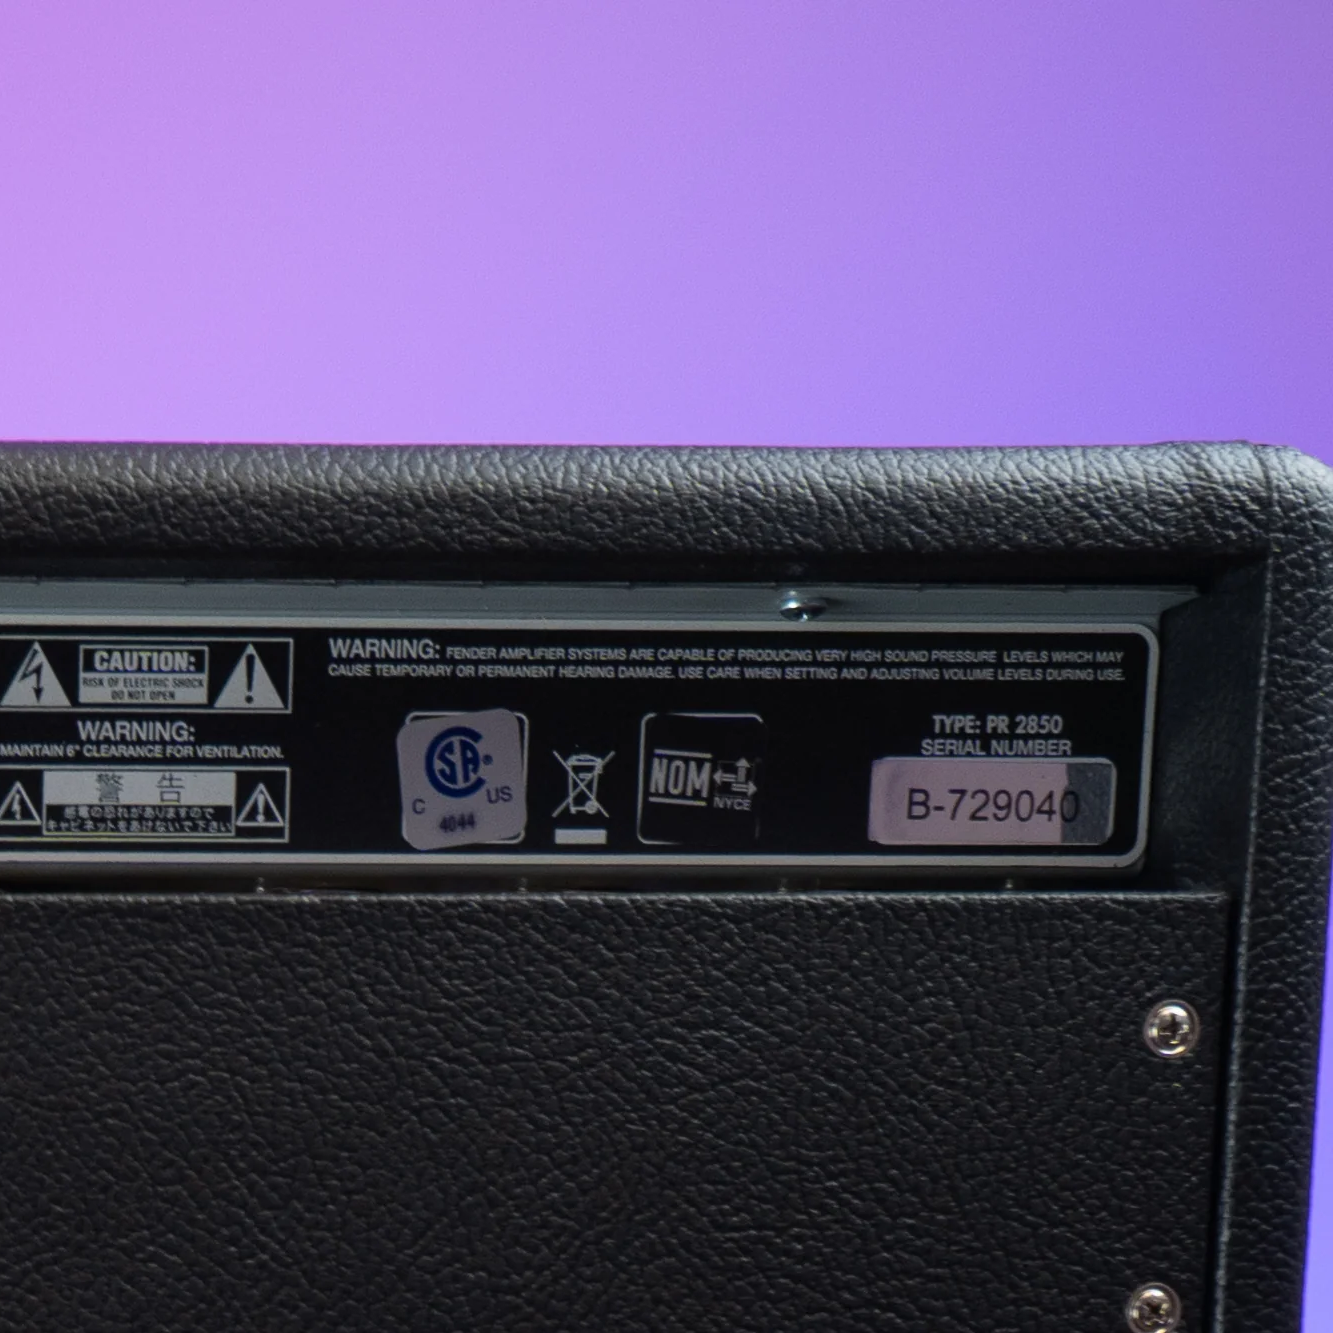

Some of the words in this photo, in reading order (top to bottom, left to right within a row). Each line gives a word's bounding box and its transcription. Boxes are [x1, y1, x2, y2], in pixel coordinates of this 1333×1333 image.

[328, 637, 440, 660] WARNING:
[446, 646, 497, 660] FENDER
[498, 646, 566, 660] AMPLIFIER
[567, 647, 627, 661] SYSTEMS
[629, 647, 655, 661] ARE
[656, 647, 715, 661] CAPABLE
[717, 648, 736, 661] OF
[738, 648, 813, 661] PRODUCING
[815, 648, 849, 662] VERY
[850, 648, 882, 662] HIGH
[884, 649, 929, 662] SOUND
[931, 649, 997, 662] PRESSURE
[1003, 649, 1048, 663] LEVELS
[1050, 650, 1094, 663] WHICH
[1096, 650, 1125, 663] MAY
[93, 650, 197, 672] CAUTION:
[328, 663, 372, 677] CAUSE
[374, 663, 453, 677] TEMPORARY
[455, 664, 476, 678] OR
[478, 664, 556, 678] PERMANENT
[558, 664, 614, 678] HEARING
[617, 665, 675, 678] DAMAGE.
[678, 665, 704, 679] USE
[706, 665, 741, 679] CARE
[743, 665, 782, 679] WHEN
[784, 666, 838, 679] SETTING
[840, 666, 868, 679] AND
[870, 666, 941, 680] ADJUSTING
[943, 666, 994, 680] VOLUME
[998, 667, 1043, 680] LEVELS
[1046, 667, 1094, 680] DURING
[1096, 667, 1126, 681] USE.
[76, 720, 197, 742] WARNING:
[932, 714, 981, 734] TYPE:
[985, 714, 1009, 734] PR
[1015, 714, 1064, 734] 2850
[0, 744, 65, 757] MAINTAIN
[82, 745, 164, 758] CLEARANCE
[166, 745, 194, 758] FOR
[195, 746, 284, 759] VENTILATION.
[921, 739, 986, 756] SERIAL
[990, 739, 1072, 756] NUMBER
[649, 757, 711, 798] NOM
[486, 786, 513, 804] US
[412, 798, 426, 814] C
[906, 788, 1080, 823] B-729040
